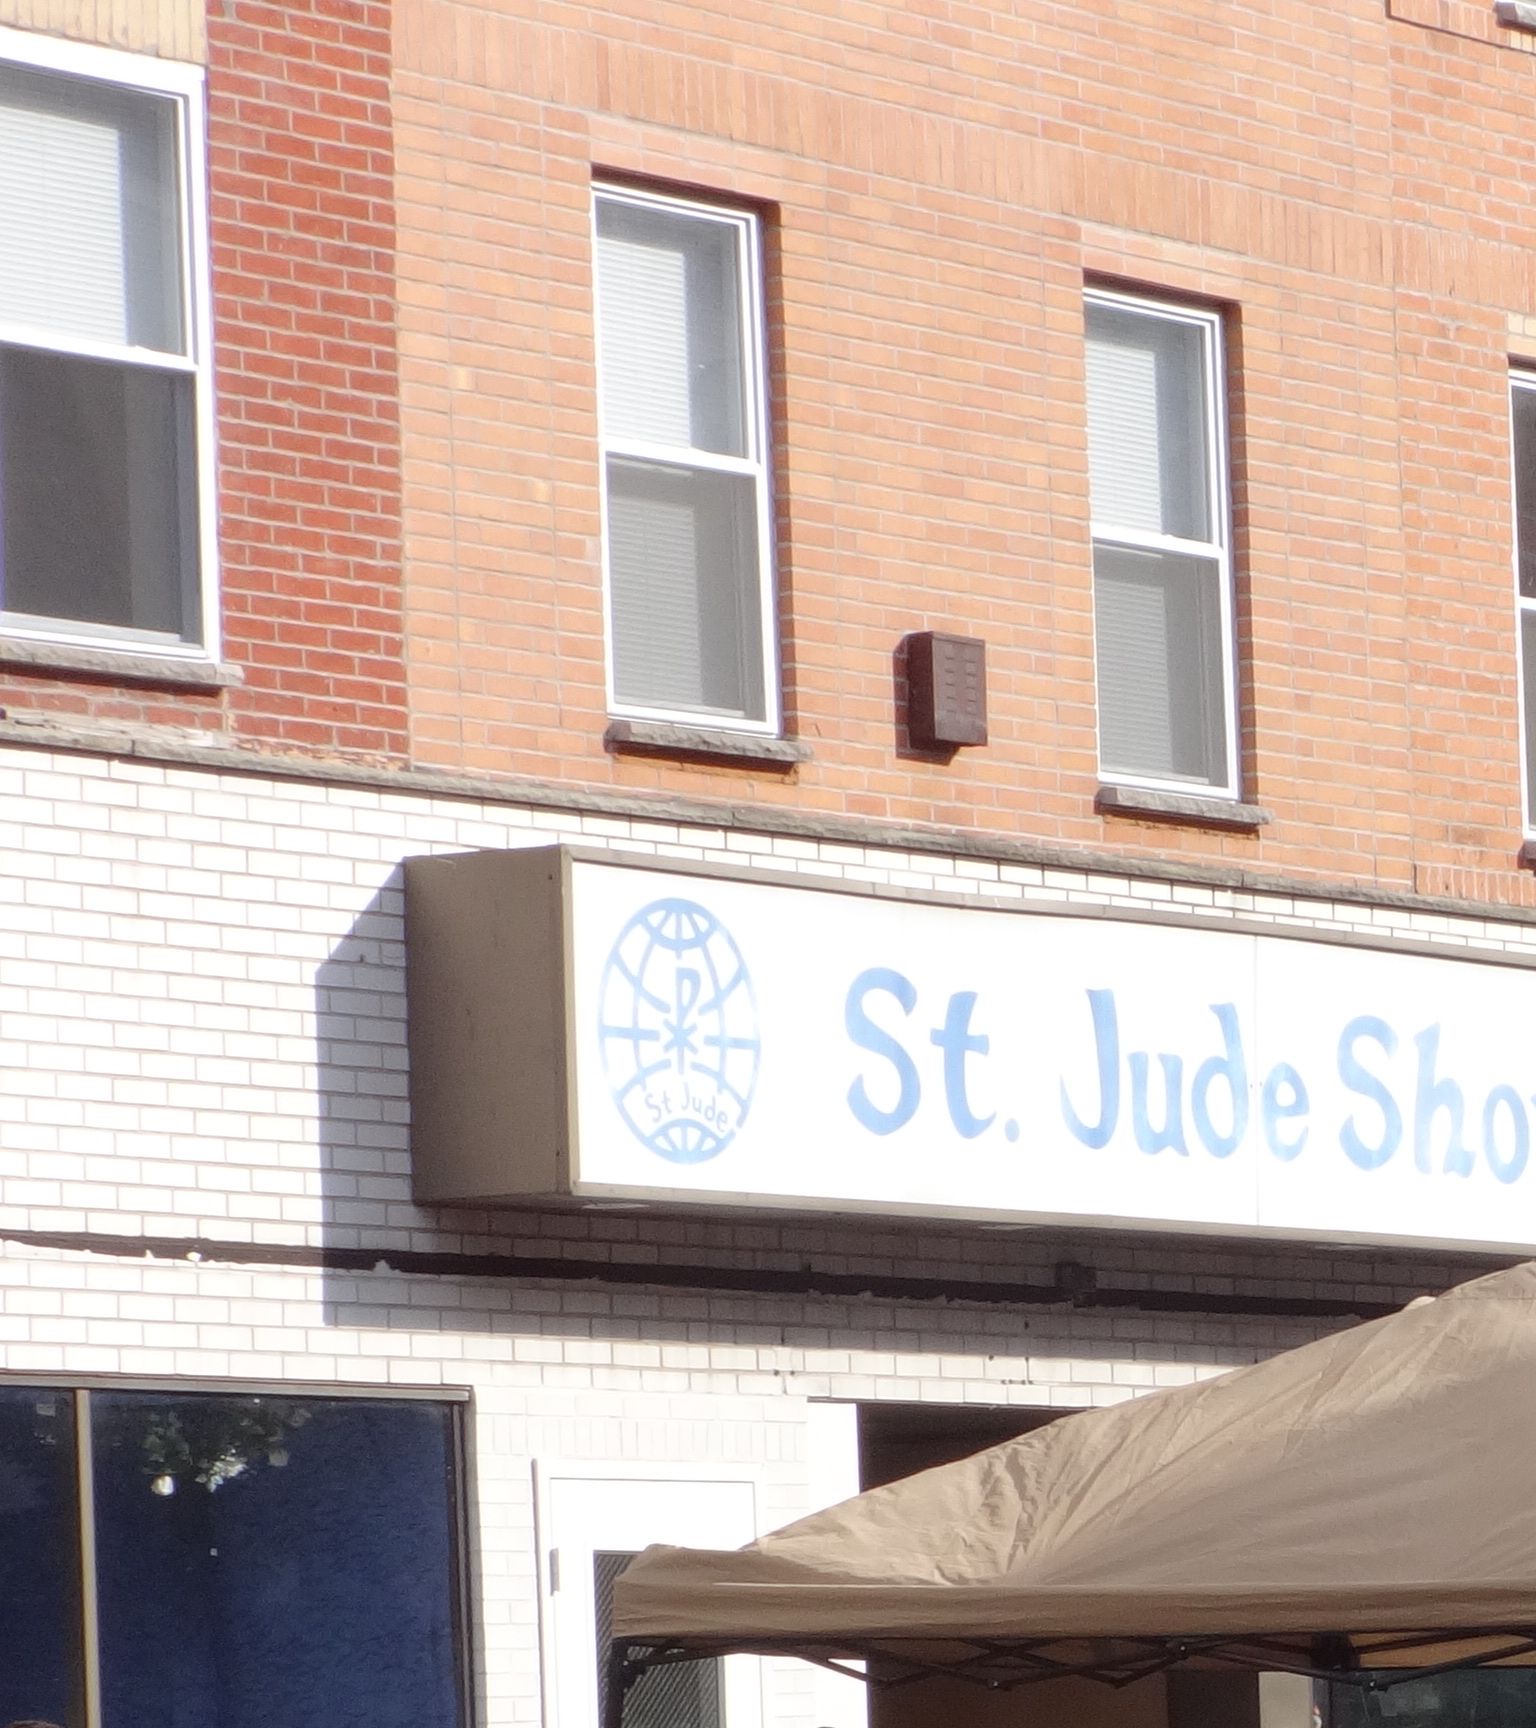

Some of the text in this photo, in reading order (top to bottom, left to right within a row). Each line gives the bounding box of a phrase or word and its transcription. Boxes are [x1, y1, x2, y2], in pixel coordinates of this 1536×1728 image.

[644, 1081, 729, 1133] St Jude
[844, 966, 1021, 1142] St.
[1059, 987, 1311, 1163] Jude
